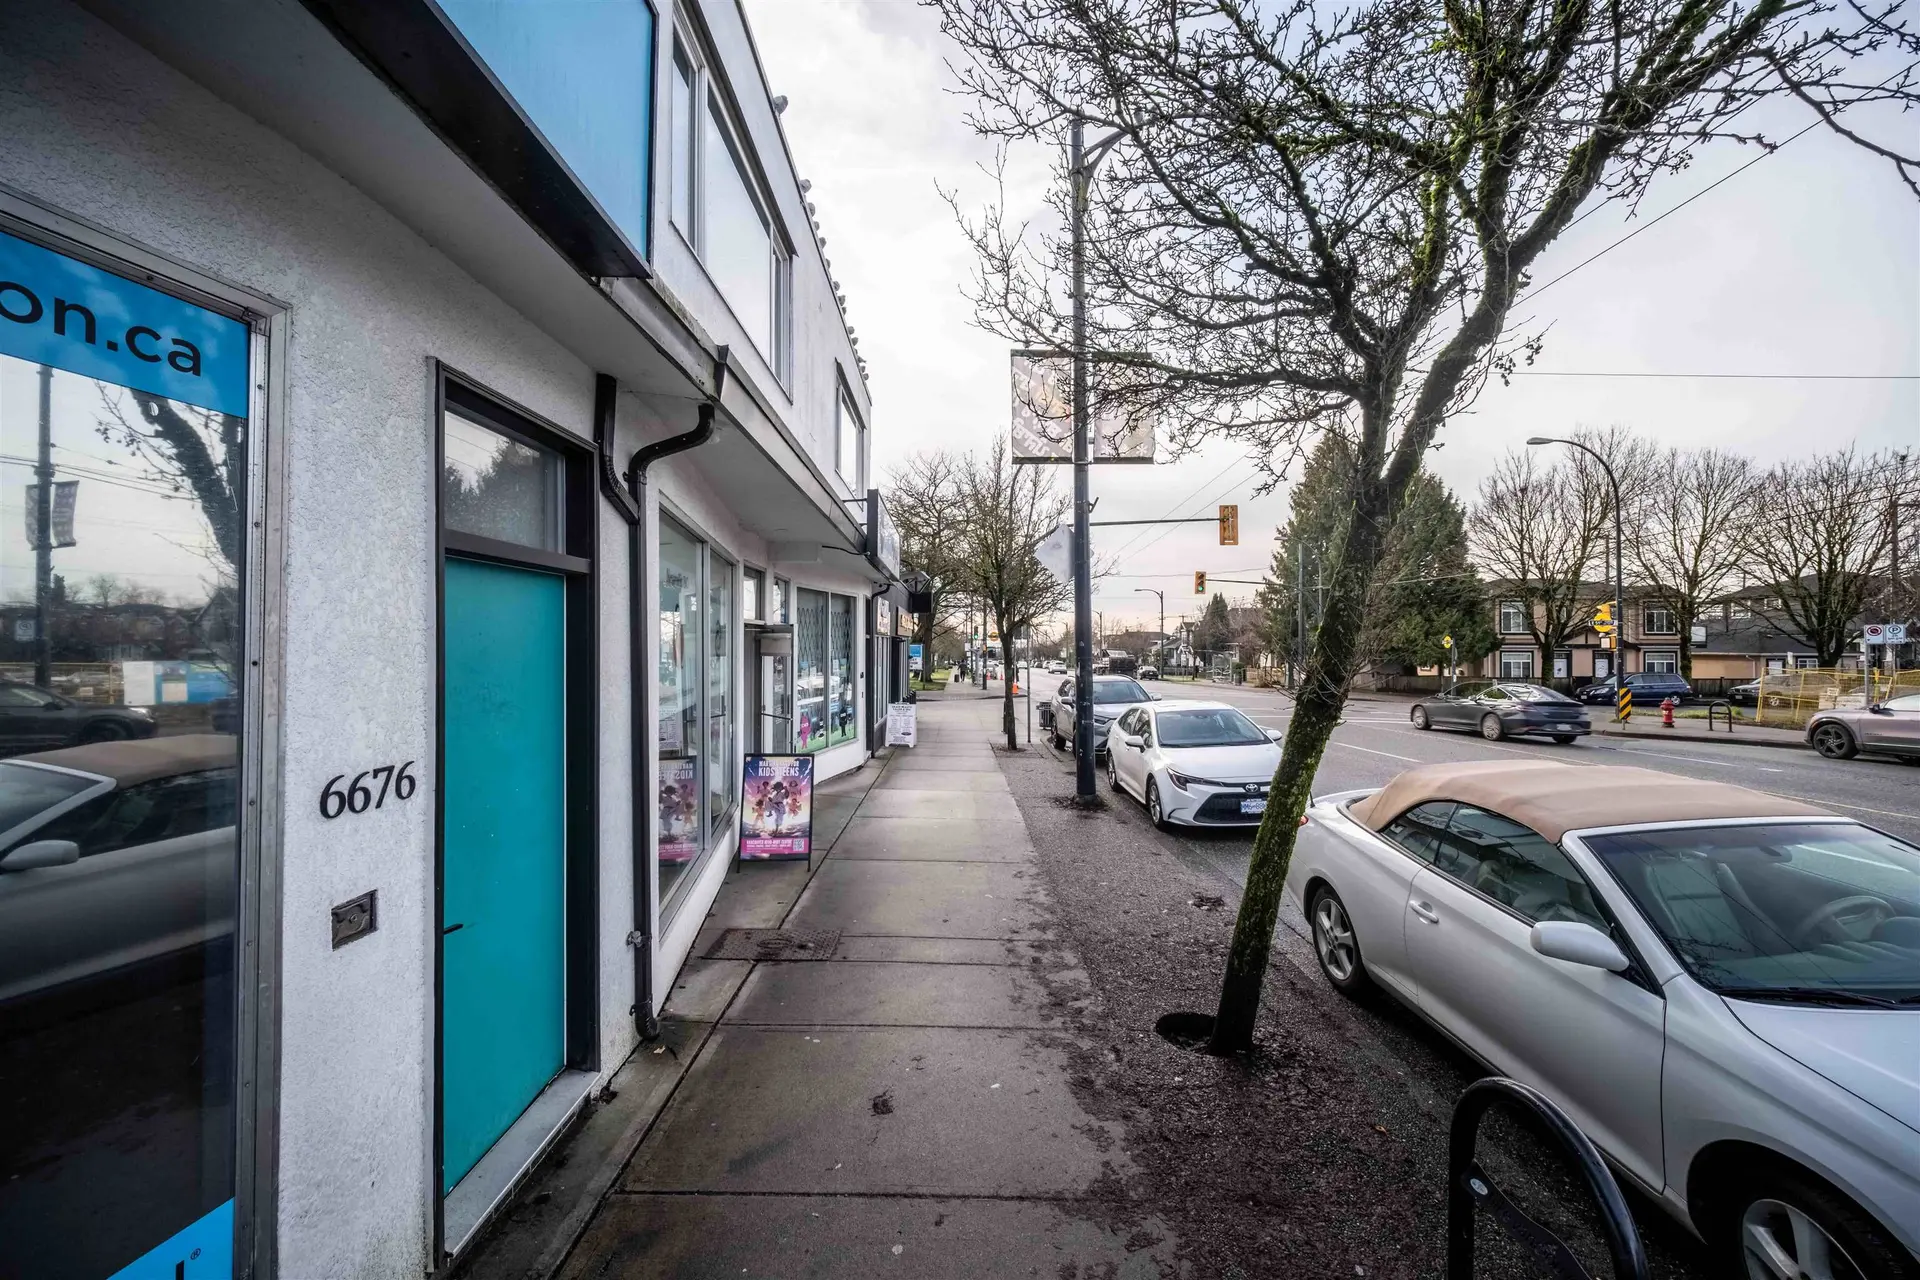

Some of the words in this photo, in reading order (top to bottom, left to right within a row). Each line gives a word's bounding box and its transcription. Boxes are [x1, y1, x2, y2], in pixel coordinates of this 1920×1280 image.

[0, 280, 201, 377] on.ca
[319, 760, 417, 820] 6676
[758, 767, 774, 776] KIDS
